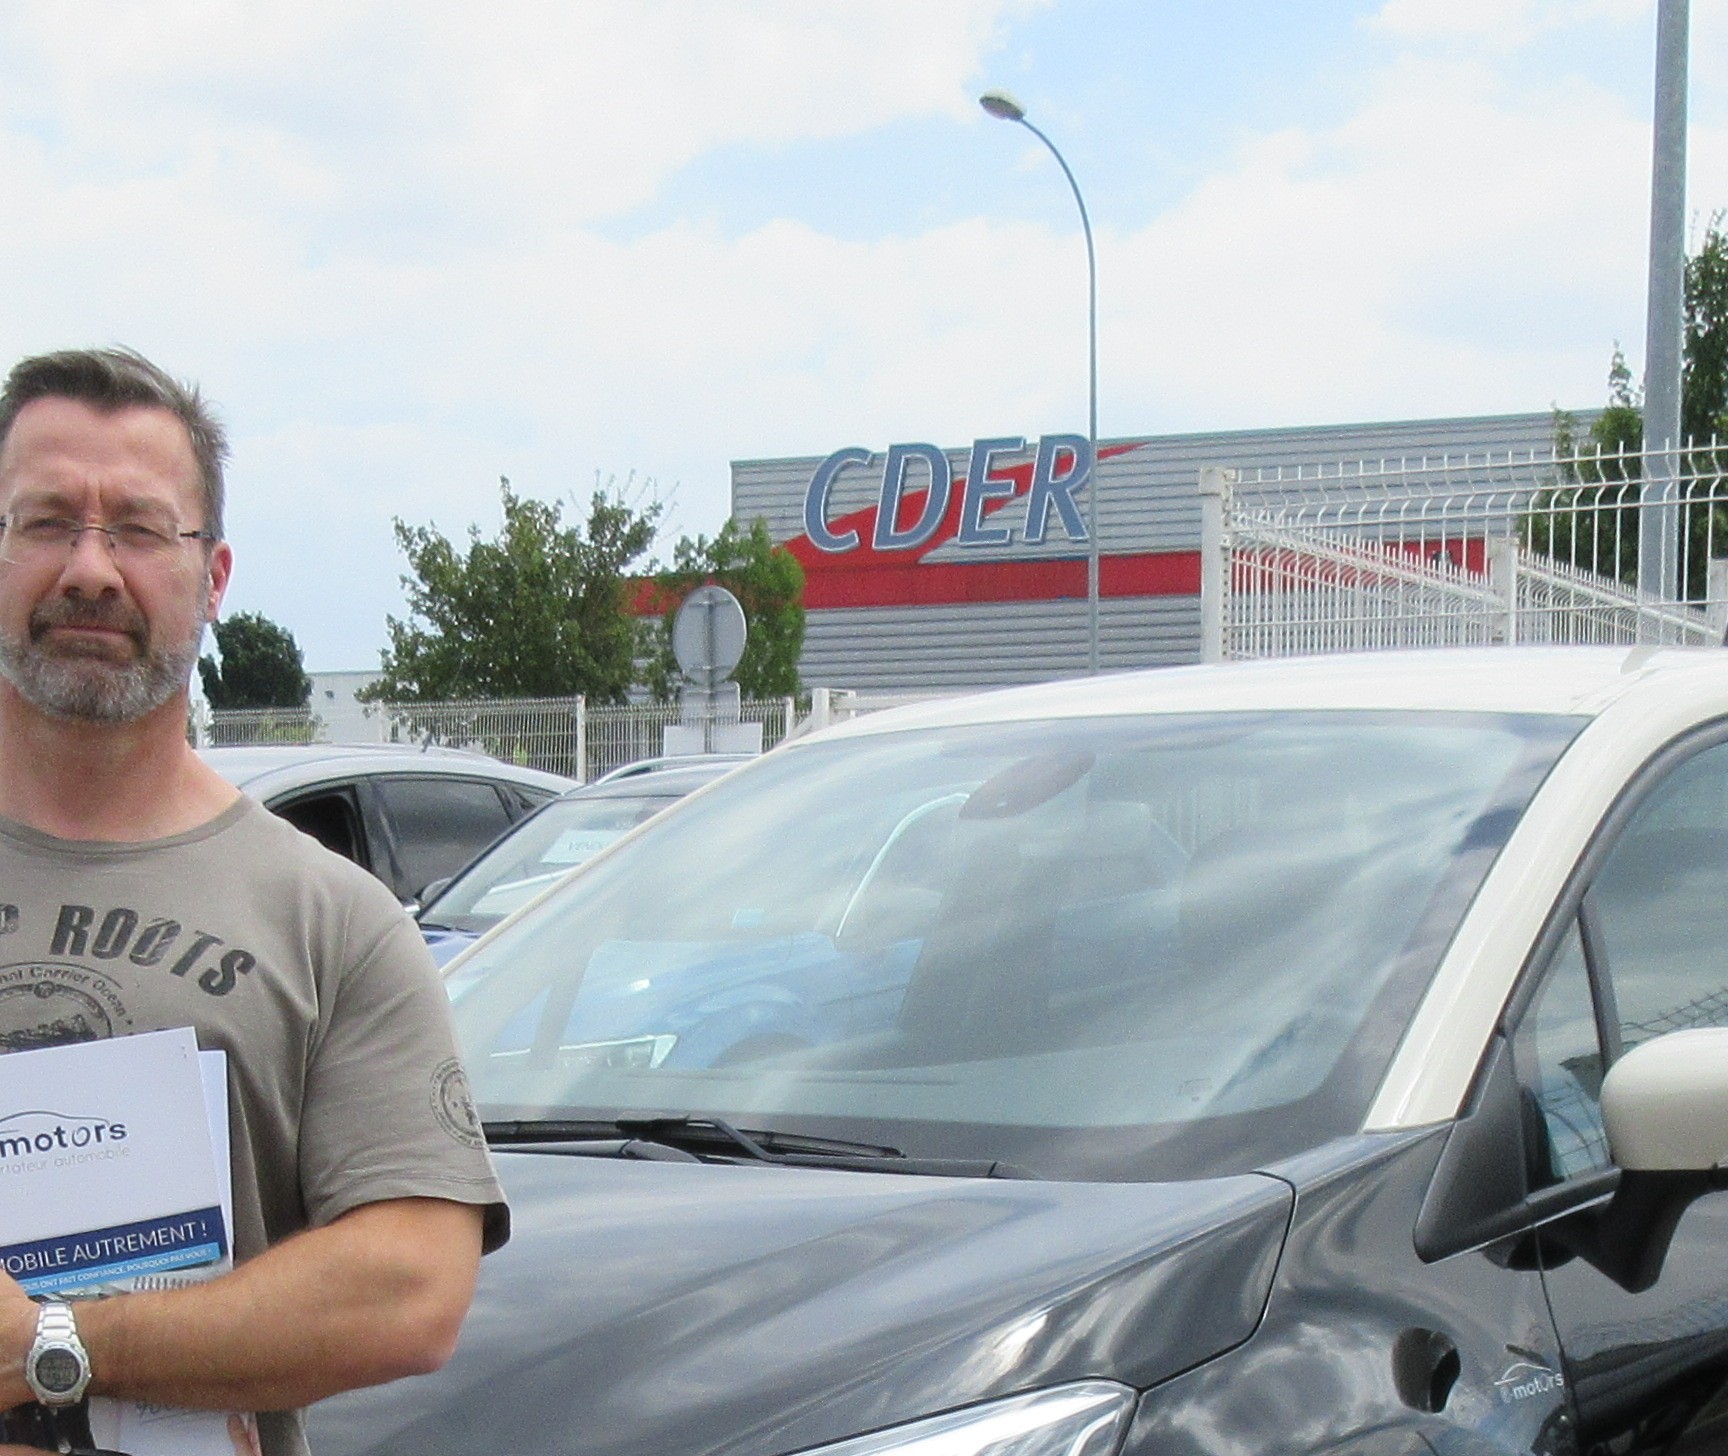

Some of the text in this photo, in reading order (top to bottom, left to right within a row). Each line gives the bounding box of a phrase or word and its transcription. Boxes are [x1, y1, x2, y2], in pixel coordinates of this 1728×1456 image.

[802, 433, 1091, 554] CDER
[49, 903, 257, 997] ROOTS
[73, 1221, 196, 1263] AUTREMENT
